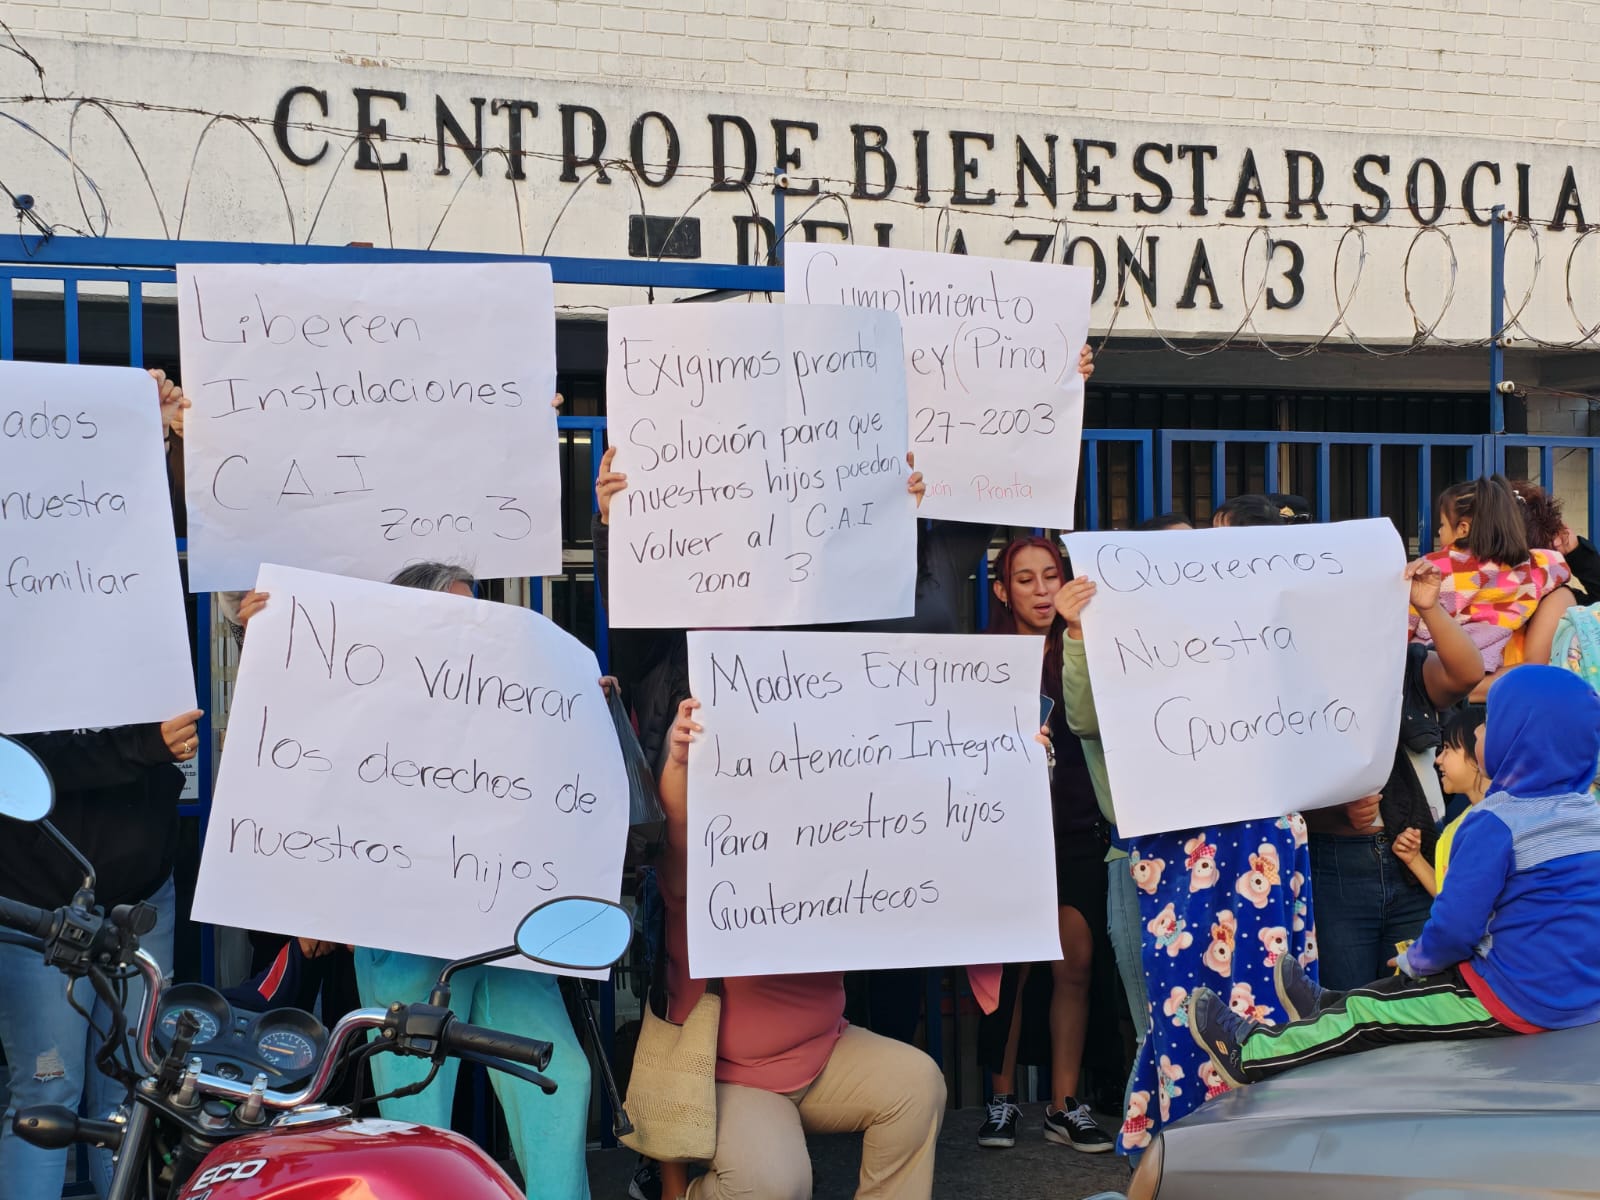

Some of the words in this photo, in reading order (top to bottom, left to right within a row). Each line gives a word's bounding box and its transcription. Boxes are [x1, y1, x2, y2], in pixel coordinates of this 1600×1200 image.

[273, 86, 682, 187] CENTRO
[706, 113, 822, 197] DE
[850, 123, 1327, 219] BIENESTAR
[1352, 154, 1590, 233] SOCIA
[1266, 238, 1305, 309] 3
[192, 274, 422, 348] Liberen
[202, 370, 523, 419] Instalaciones
[619, 336, 781, 408] Exigimos
[792, 332, 880, 418] pronta
[629, 417, 769, 473] Solución
[780, 419, 838, 463] para
[848, 412, 883, 453] que
[914, 402, 1056, 445] 27-2003
[1, 479, 126, 520] nuestra
[485, 495, 532, 538] 3
[624, 467, 754, 517] nuestros
[764, 455, 825, 504] hijos
[747, 512, 775, 549] al
[5, 555, 140, 597] familiar
[1096, 543, 1344, 592] Queremos
[285, 595, 385, 687] No
[1114, 619, 1298, 675] Nuestra
[710, 649, 843, 714] Madres
[861, 651, 1011, 707] Exigimos
[256, 704, 334, 771] los
[357, 742, 533, 801] derechos
[554, 772, 597, 814] de
[714, 733, 753, 778] La
[769, 721, 892, 781] atención
[894, 703, 1031, 776] Integral
[1153, 696, 1356, 761] Guardería
[704, 814, 769, 868] Para
[795, 791, 927, 848] nuestros
[945, 776, 1005, 843] hijos
[229, 817, 410, 869] nuestros
[451, 834, 560, 913] hijos
[708, 868, 940, 932] Guatemaltecos
[191, 1158, 268, 1192] ECO
